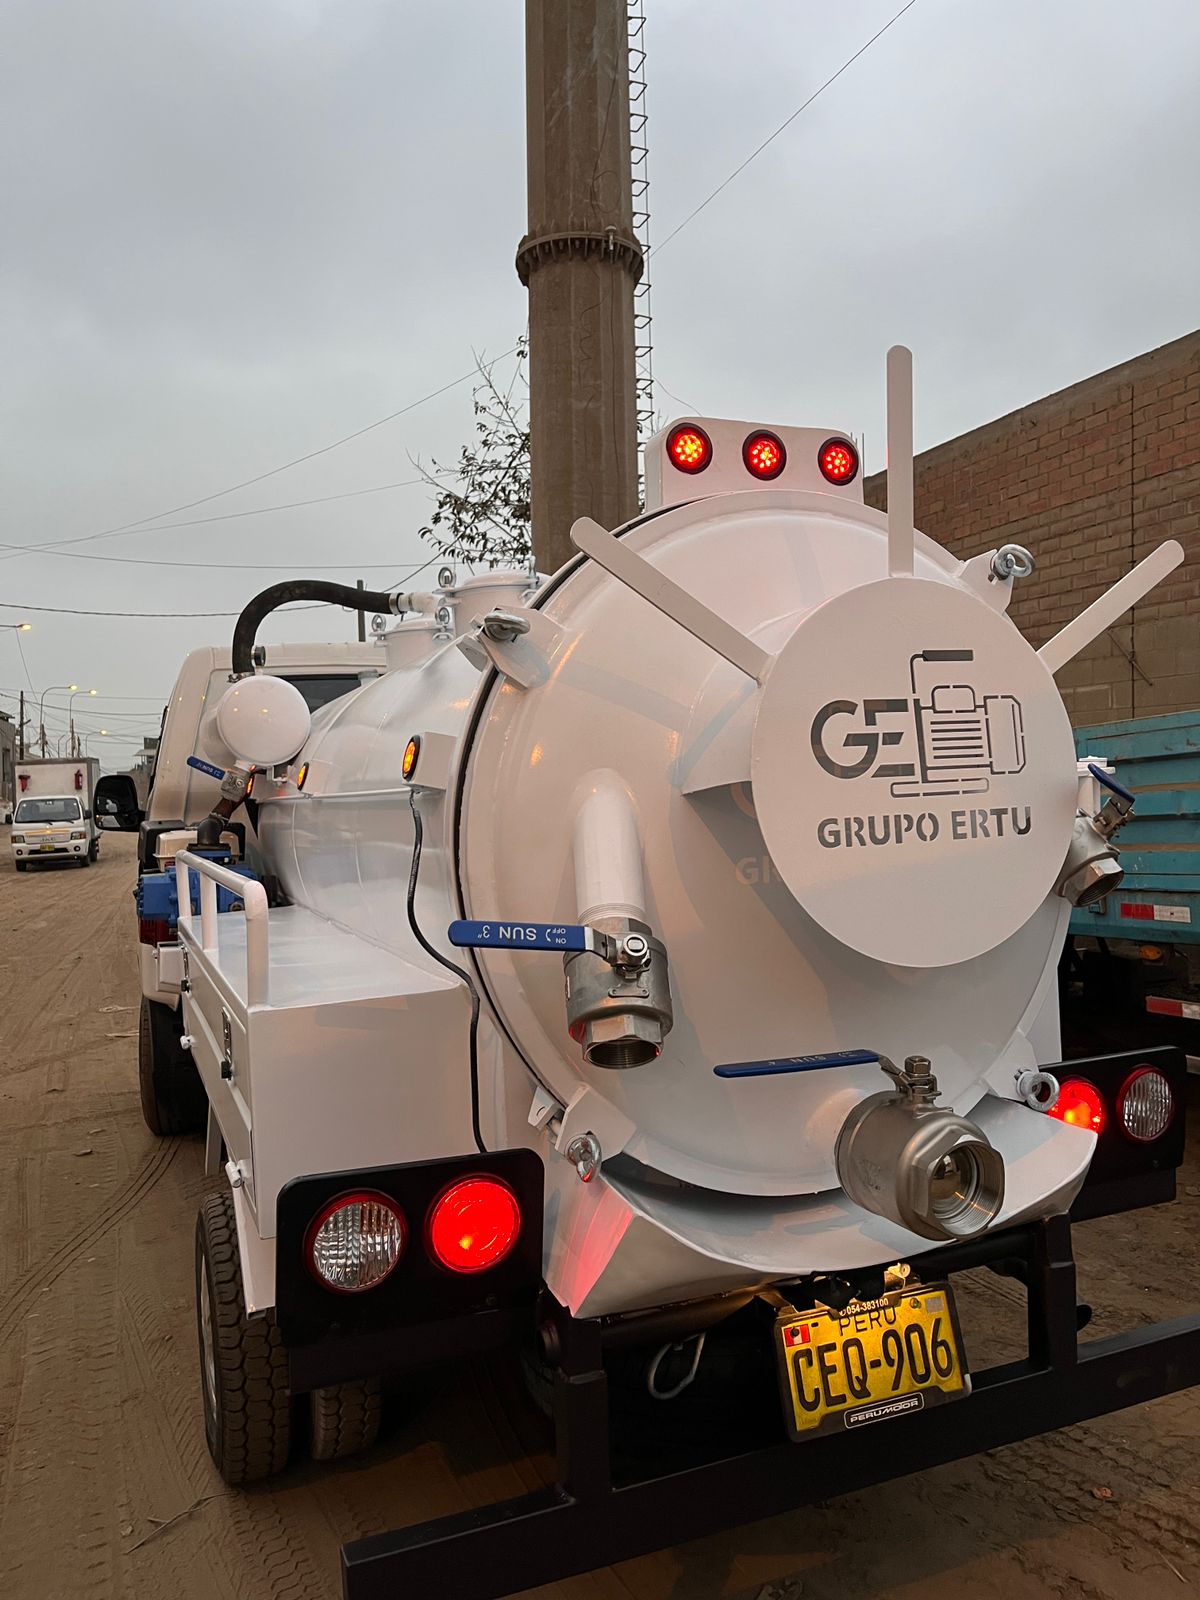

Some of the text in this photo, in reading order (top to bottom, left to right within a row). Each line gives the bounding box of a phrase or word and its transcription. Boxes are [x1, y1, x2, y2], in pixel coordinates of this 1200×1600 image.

[817, 806, 1031, 849] GRUPO ERTU
[499, 927, 537, 941] SUN
[839, 1306, 897, 1336] PERU
[846, 1297, 889, 1315] 054-383100
[793, 1317, 953, 1412] CEQ-906
